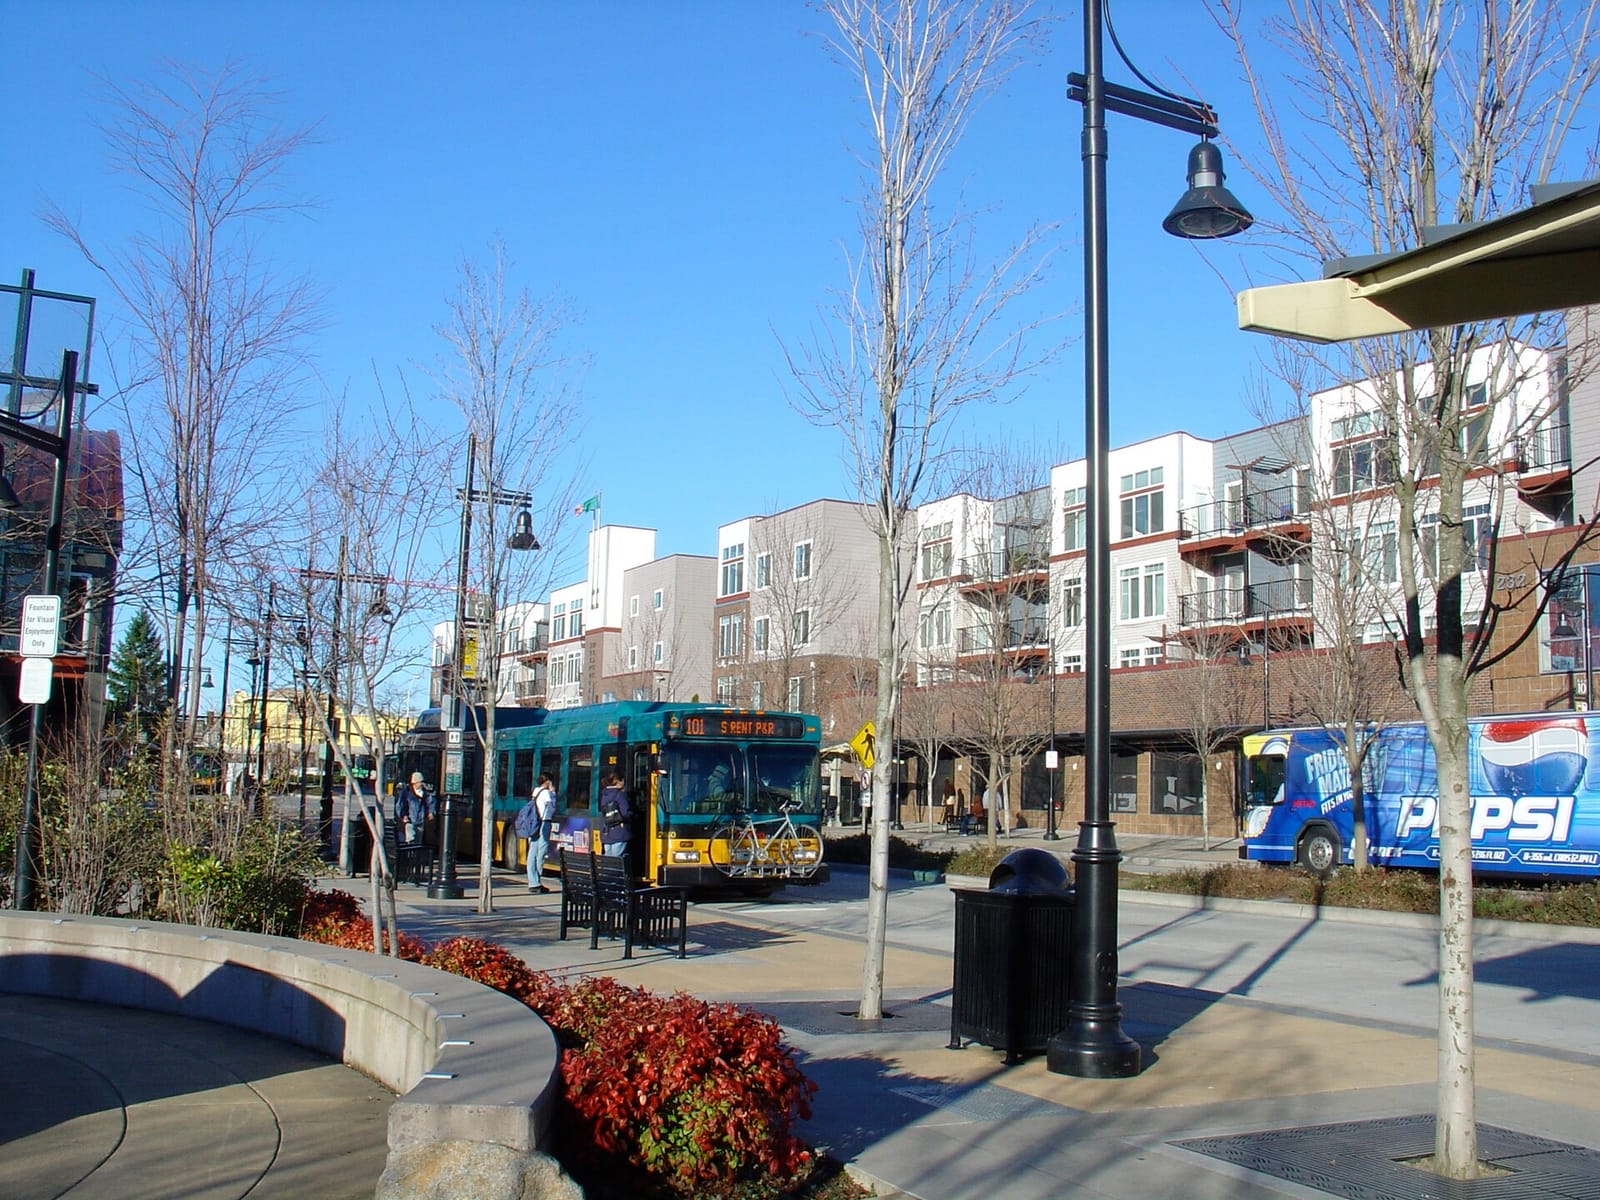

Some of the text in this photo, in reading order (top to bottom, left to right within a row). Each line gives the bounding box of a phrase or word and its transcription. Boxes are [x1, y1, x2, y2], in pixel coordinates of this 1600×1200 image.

[1496, 573, 1526, 591] 232
[25, 627, 55, 636] Enjoyment
[32, 640, 45, 648] Only
[686, 718, 775, 736] 101 S RENT P&R
[1321, 797, 1336, 815] FITS
[1396, 796, 1573, 842] PPSI
